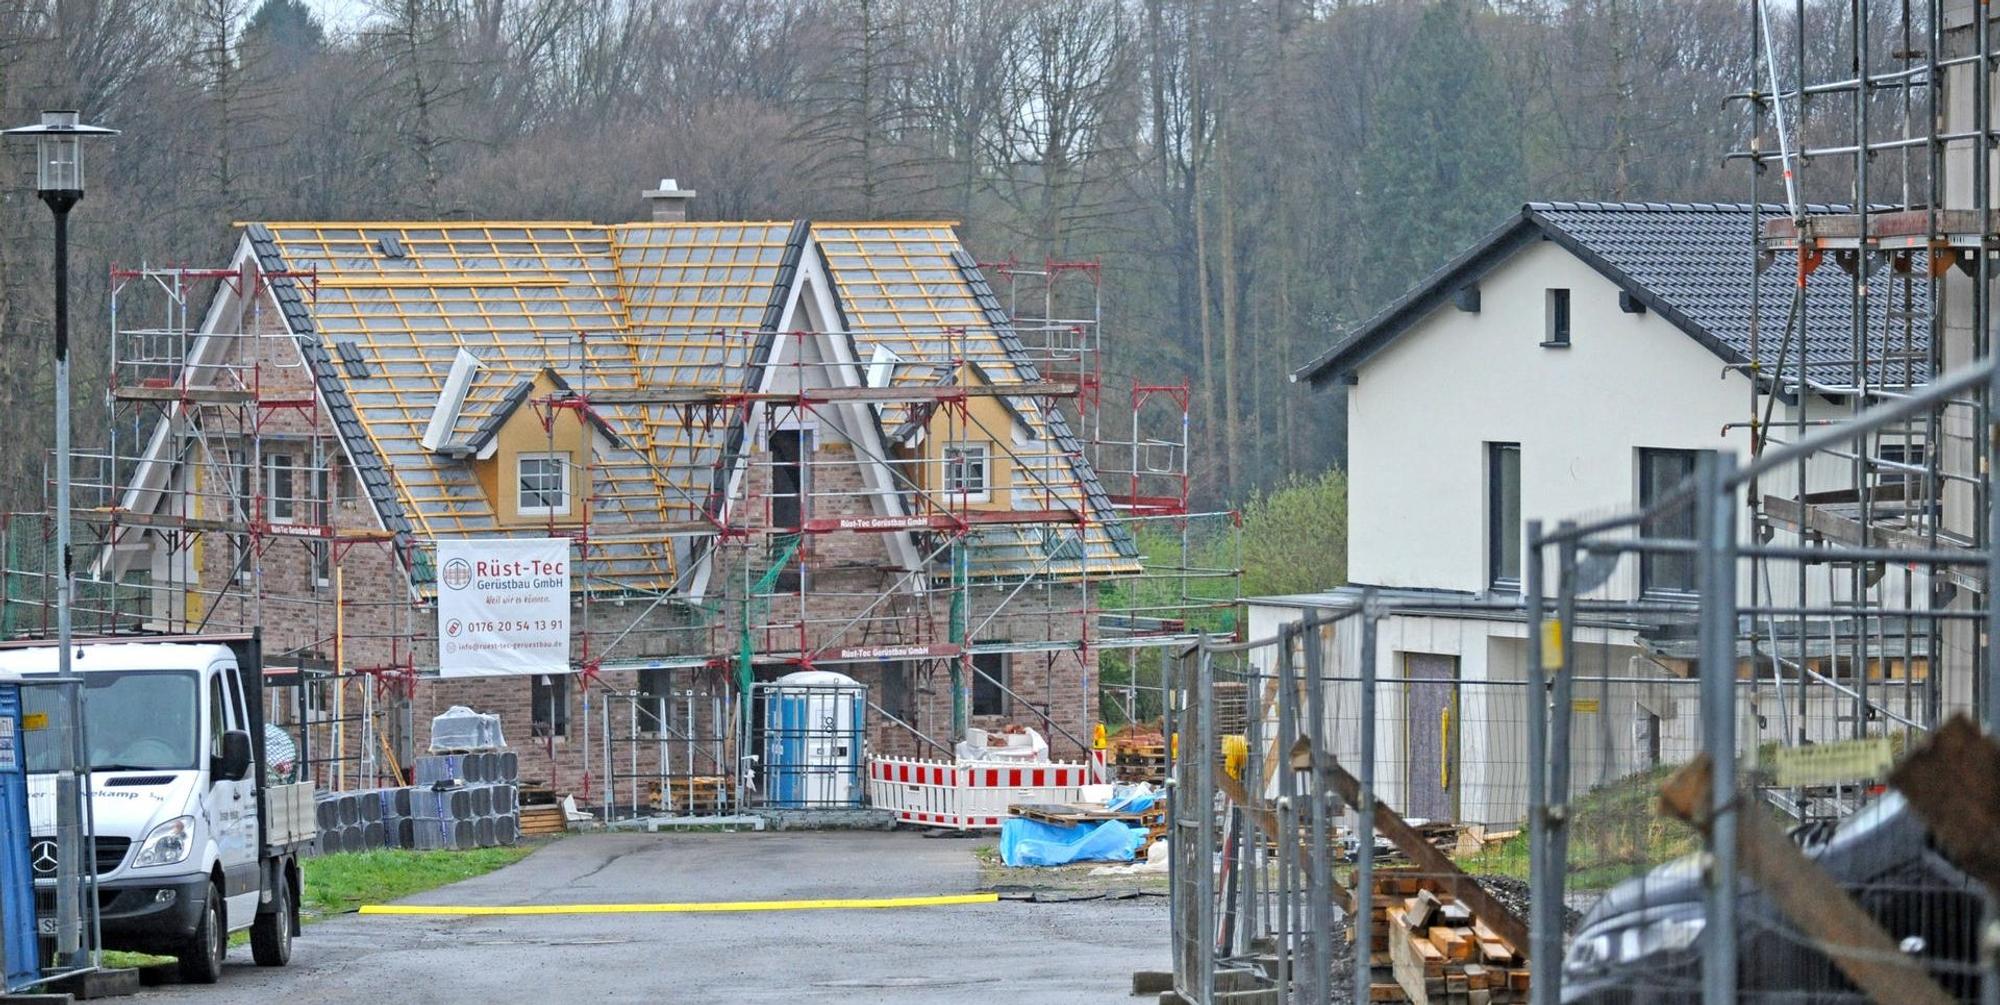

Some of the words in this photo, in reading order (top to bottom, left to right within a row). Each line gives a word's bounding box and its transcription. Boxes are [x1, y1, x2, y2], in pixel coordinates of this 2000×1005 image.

[907, 516, 928, 526] GmbH
[477, 559, 563, 577] Rüst-Tec
[477, 579, 530, 590] Gerüstbau
[533, 577, 563, 589] GmbH
[468, 621, 494, 632] 0176
[497, 621, 512, 632] 20
[516, 620, 530, 631] 54
[535, 620, 546, 631] 13
[550, 619, 563, 630] 91
[458, 641, 563, 651] info@ruest-tec-geruestbau.de
[908, 646, 929, 655] GmbH
